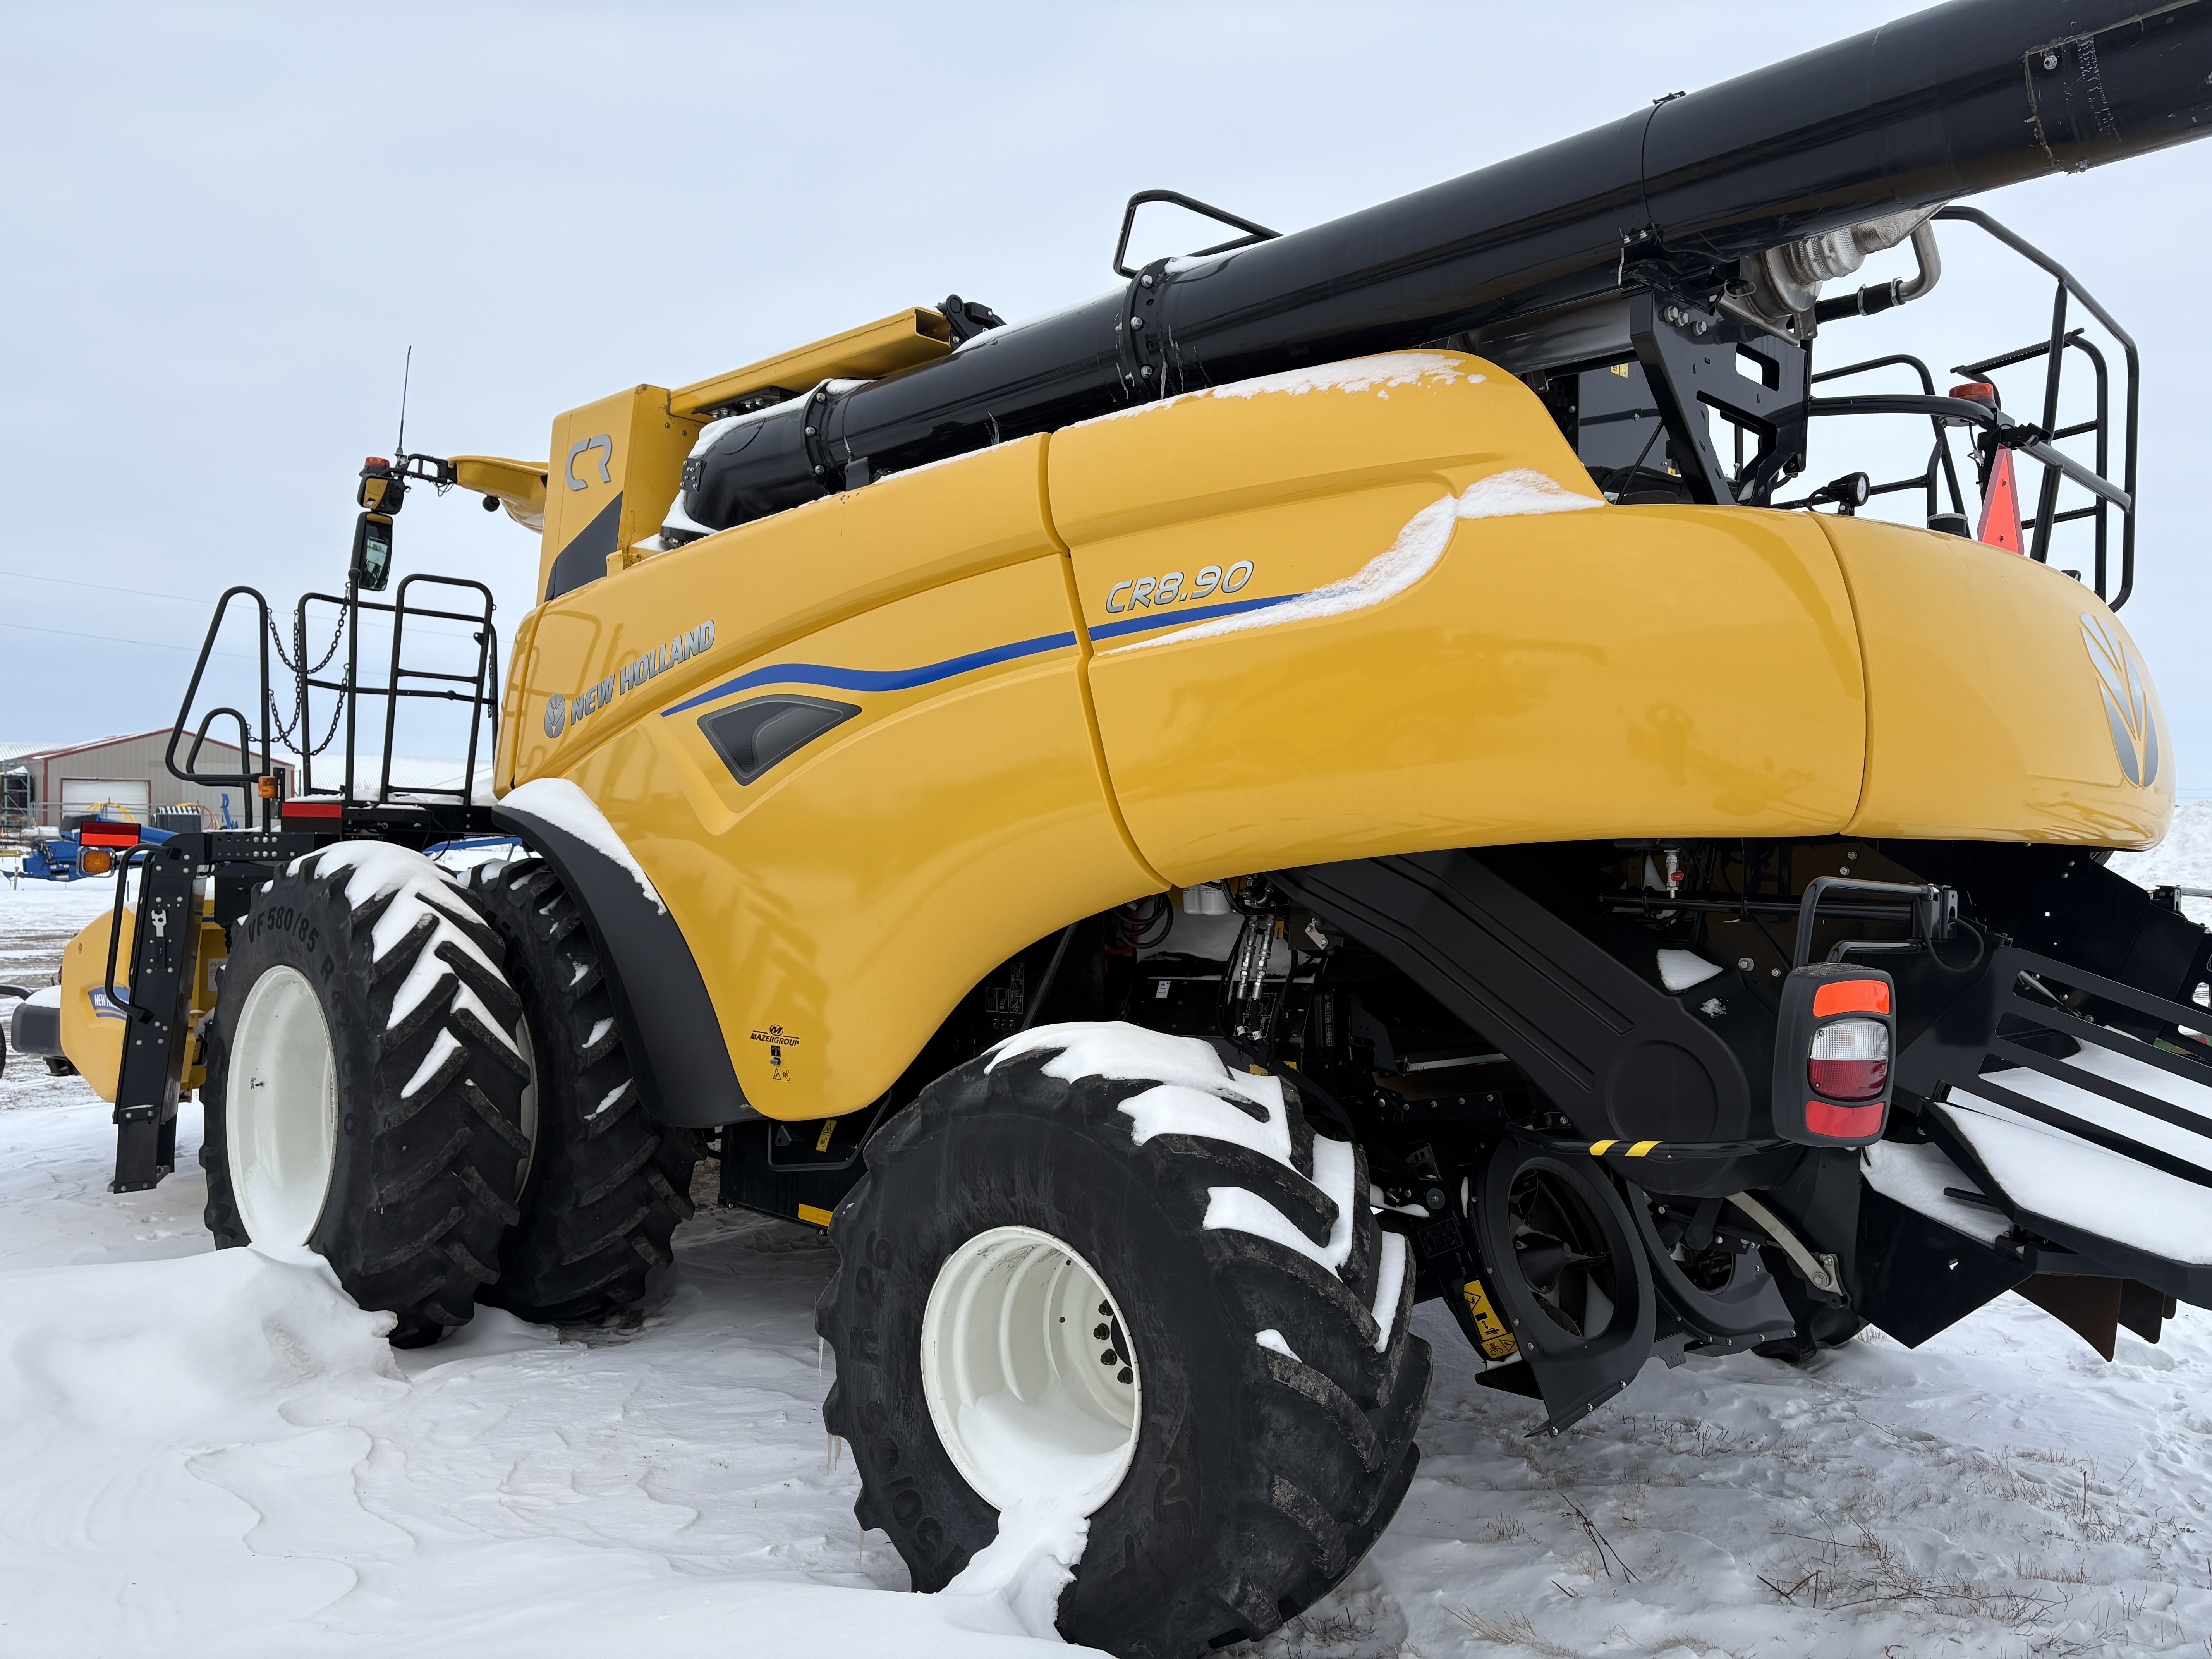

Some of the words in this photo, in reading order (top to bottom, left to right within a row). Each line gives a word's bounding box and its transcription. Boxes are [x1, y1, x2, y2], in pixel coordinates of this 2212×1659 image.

[565, 433, 613, 491] CR
[1106, 560, 1254, 613] CR8.90
[570, 673, 615, 725] NEW
[620, 620, 715, 696] HOLLAND
[267, 905, 319, 953] 580/85
[94, 994, 106, 1006] NEW
[750, 1033, 800, 1046] MAZERGROUP
